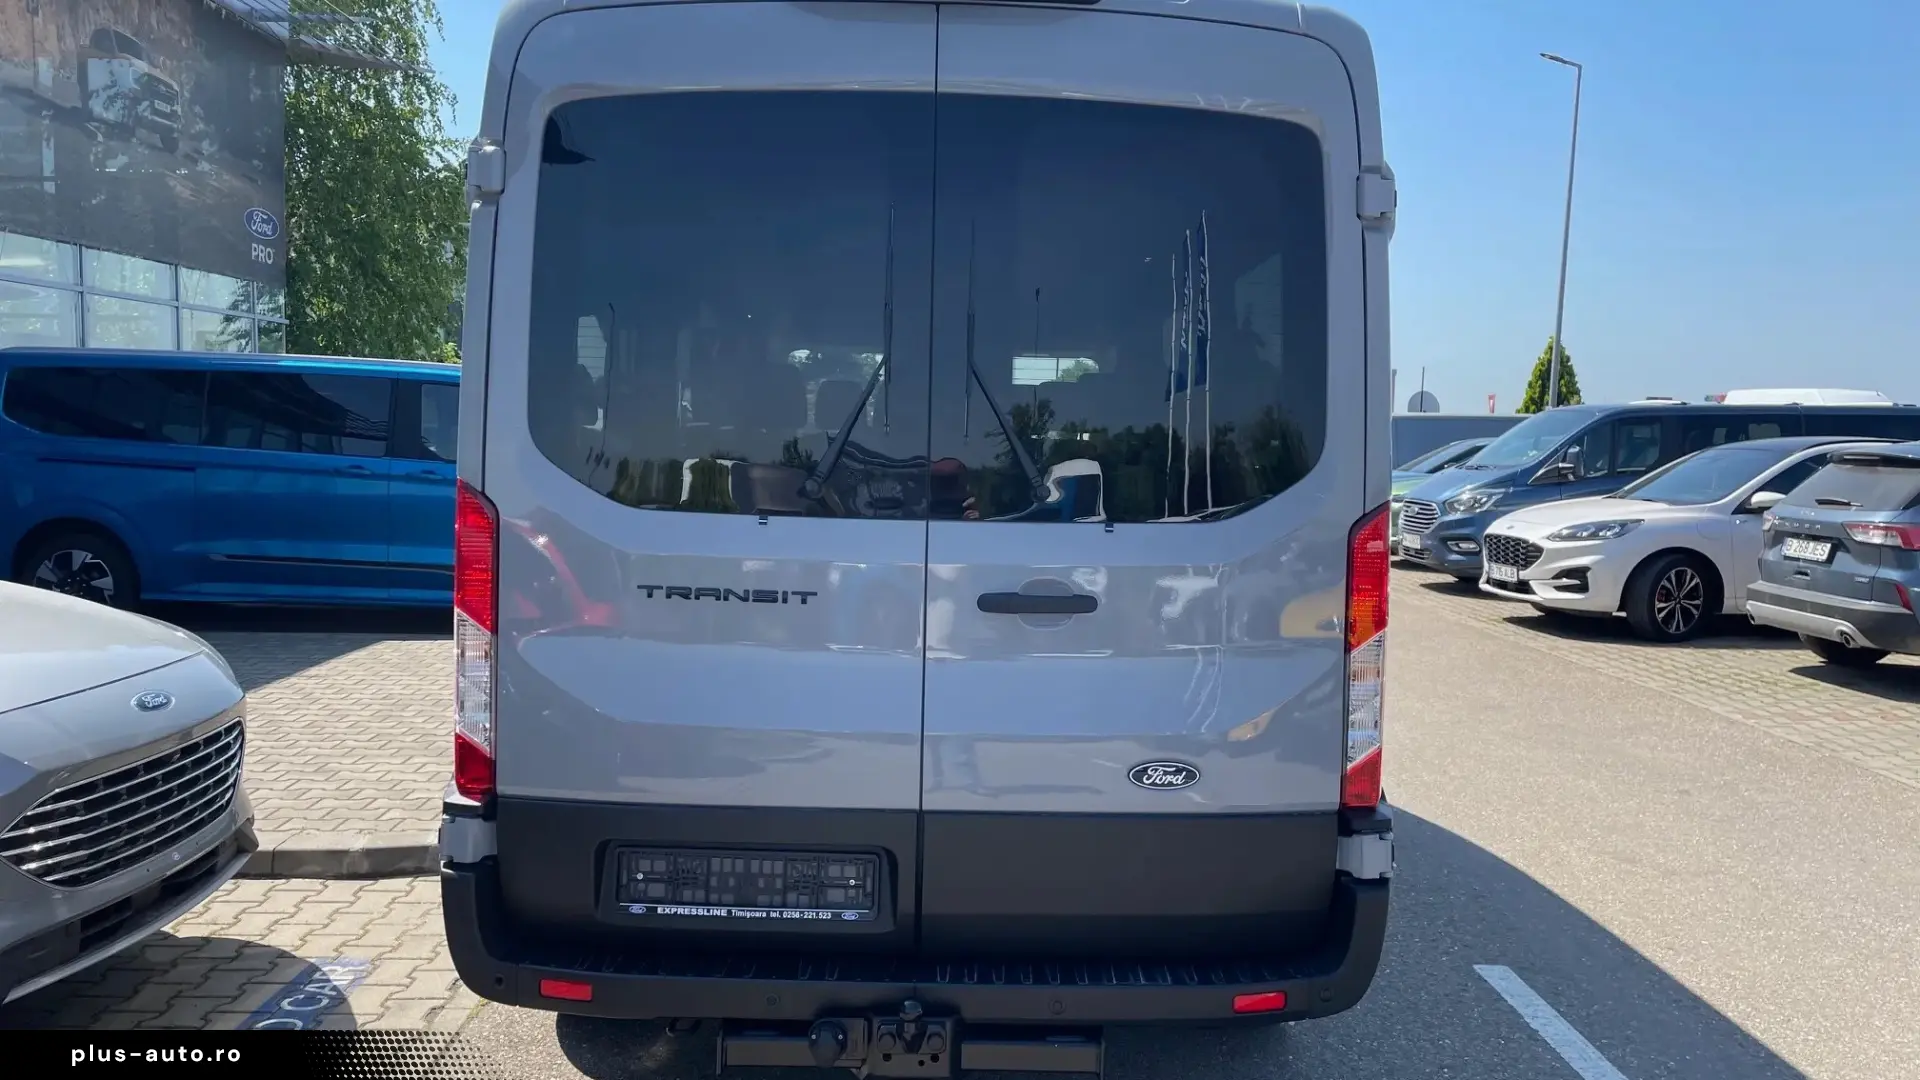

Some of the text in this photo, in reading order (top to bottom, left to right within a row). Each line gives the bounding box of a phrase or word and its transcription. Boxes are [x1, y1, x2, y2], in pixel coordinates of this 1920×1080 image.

[251, 211, 274, 236] Ford
[251, 243, 274, 265] PRO
[1786, 539, 1794, 552] B
[1809, 542, 1828, 557] JES
[637, 585, 818, 605] TRANSIT
[141, 693, 168, 708] Ford
[1143, 766, 1187, 785] Ford
[657, 906, 728, 916] EXPRESSLINE
[280, 966, 370, 1011] CAR
